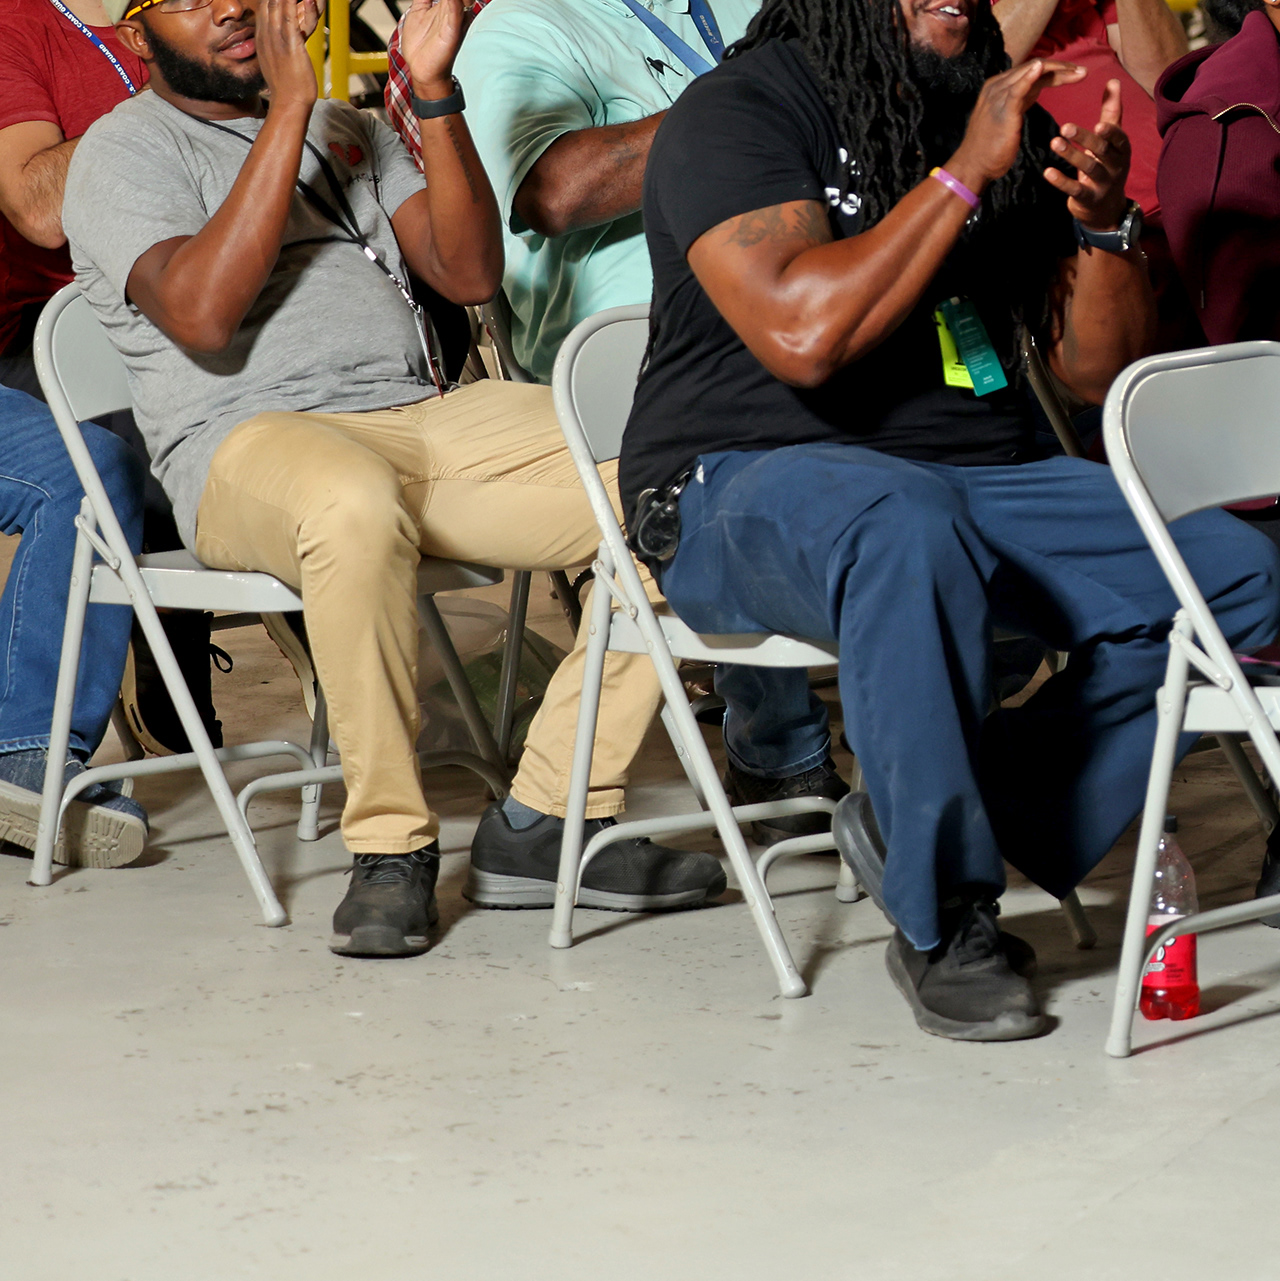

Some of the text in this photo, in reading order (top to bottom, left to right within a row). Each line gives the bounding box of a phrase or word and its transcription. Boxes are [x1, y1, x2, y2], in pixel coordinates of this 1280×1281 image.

[65, 11, 83, 29] COAST
[99, 43, 117, 63] GUARD
[114, 63, 130, 84] COAST
